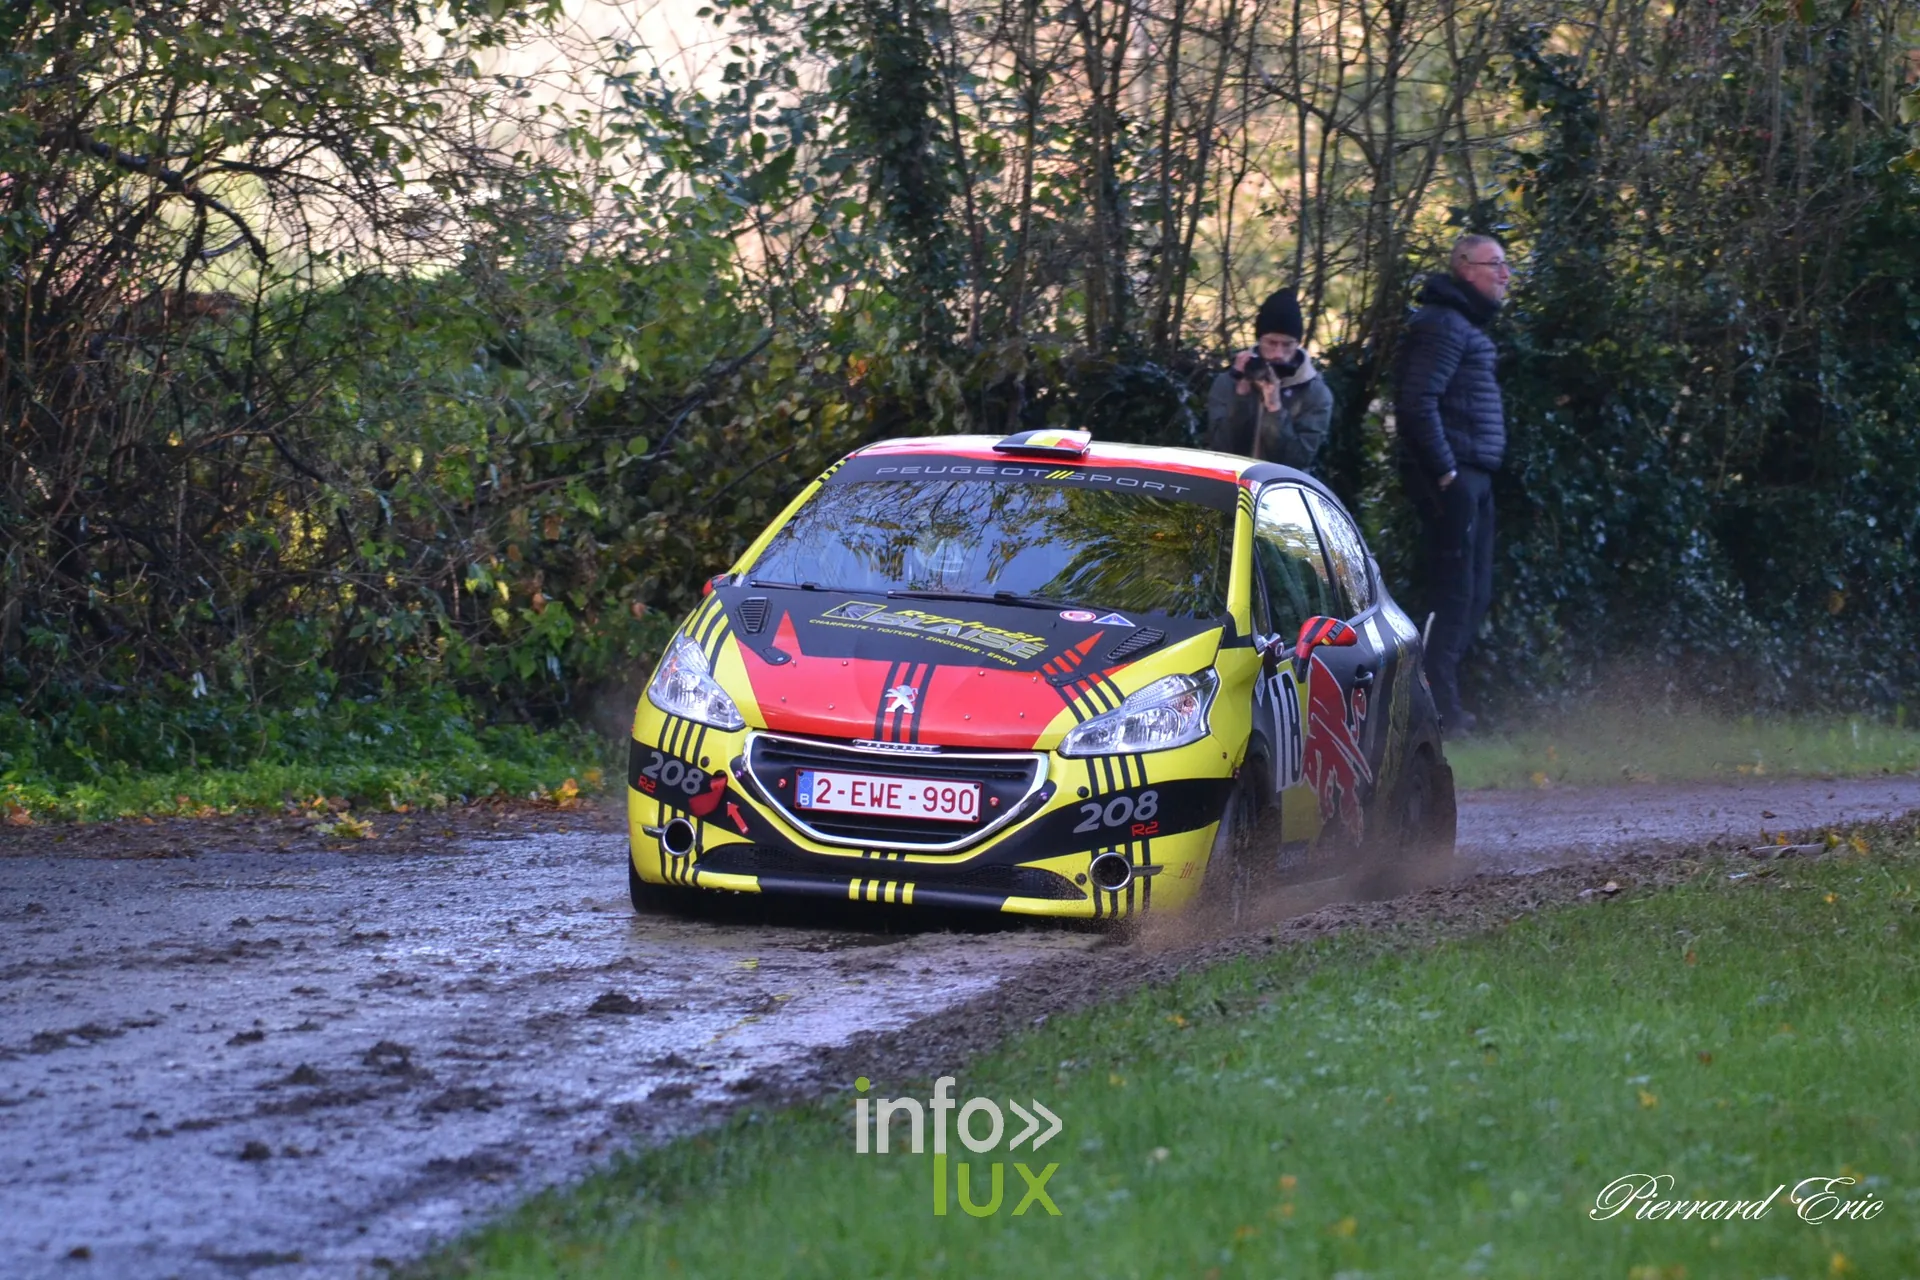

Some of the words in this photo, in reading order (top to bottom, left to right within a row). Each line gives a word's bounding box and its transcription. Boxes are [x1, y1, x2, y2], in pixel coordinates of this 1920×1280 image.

[876, 466, 1049, 477] PEUGEOT
[1066, 473, 1190, 494] SPORT
[809, 619, 868, 630] CHARPENTE
[877, 627, 920, 638] TOITURE
[926, 635, 980, 653] ZINGUERIE
[987, 651, 1018, 666] EPDM
[862, 612, 1045, 660] BLAISE
[1271, 673, 1302, 788] 18
[637, 775, 657, 794] R2
[641, 751, 704, 795] 208
[800, 793, 810, 806] B
[815, 778, 975, 815] 2-EWE-990
[1072, 790, 1159, 834] 208
[1131, 821, 1160, 837] R2
